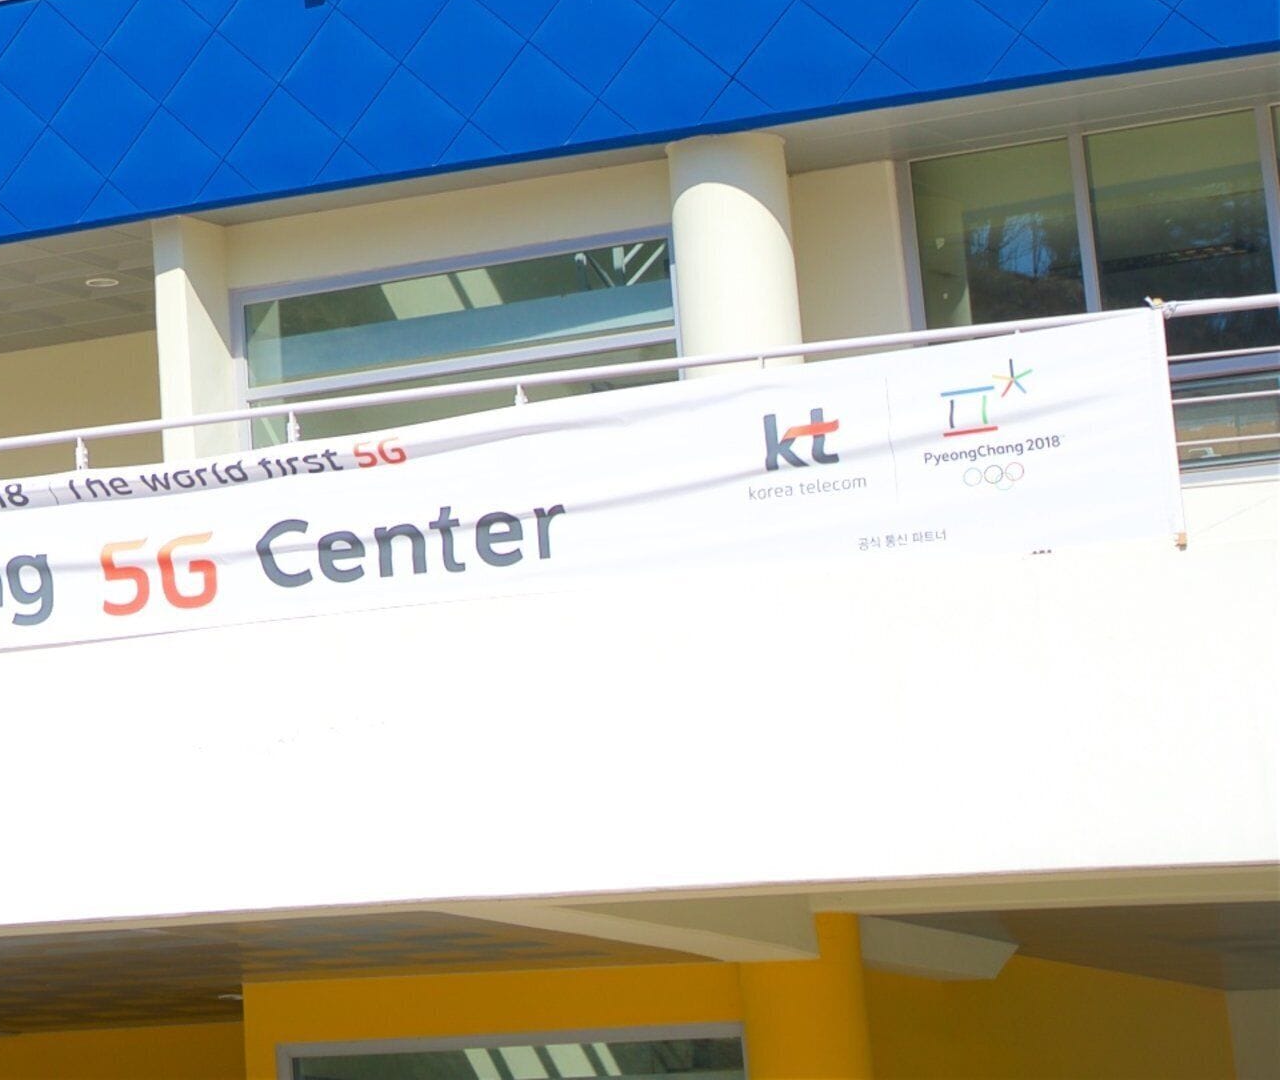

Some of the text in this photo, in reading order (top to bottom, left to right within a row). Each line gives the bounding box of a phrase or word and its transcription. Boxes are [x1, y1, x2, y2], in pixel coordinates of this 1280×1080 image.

[763, 407, 840, 471] kt
[924, 435, 1062, 466] PyeongChang 2018
[140, 460, 248, 493] world
[258, 448, 344, 479] first
[354, 437, 408, 468] 5G
[748, 475, 868, 501] korea telecom
[100, 531, 218, 616] 5G
[256, 503, 566, 588] Center
[857, 529, 947, 552] 공식 통신 파트너
